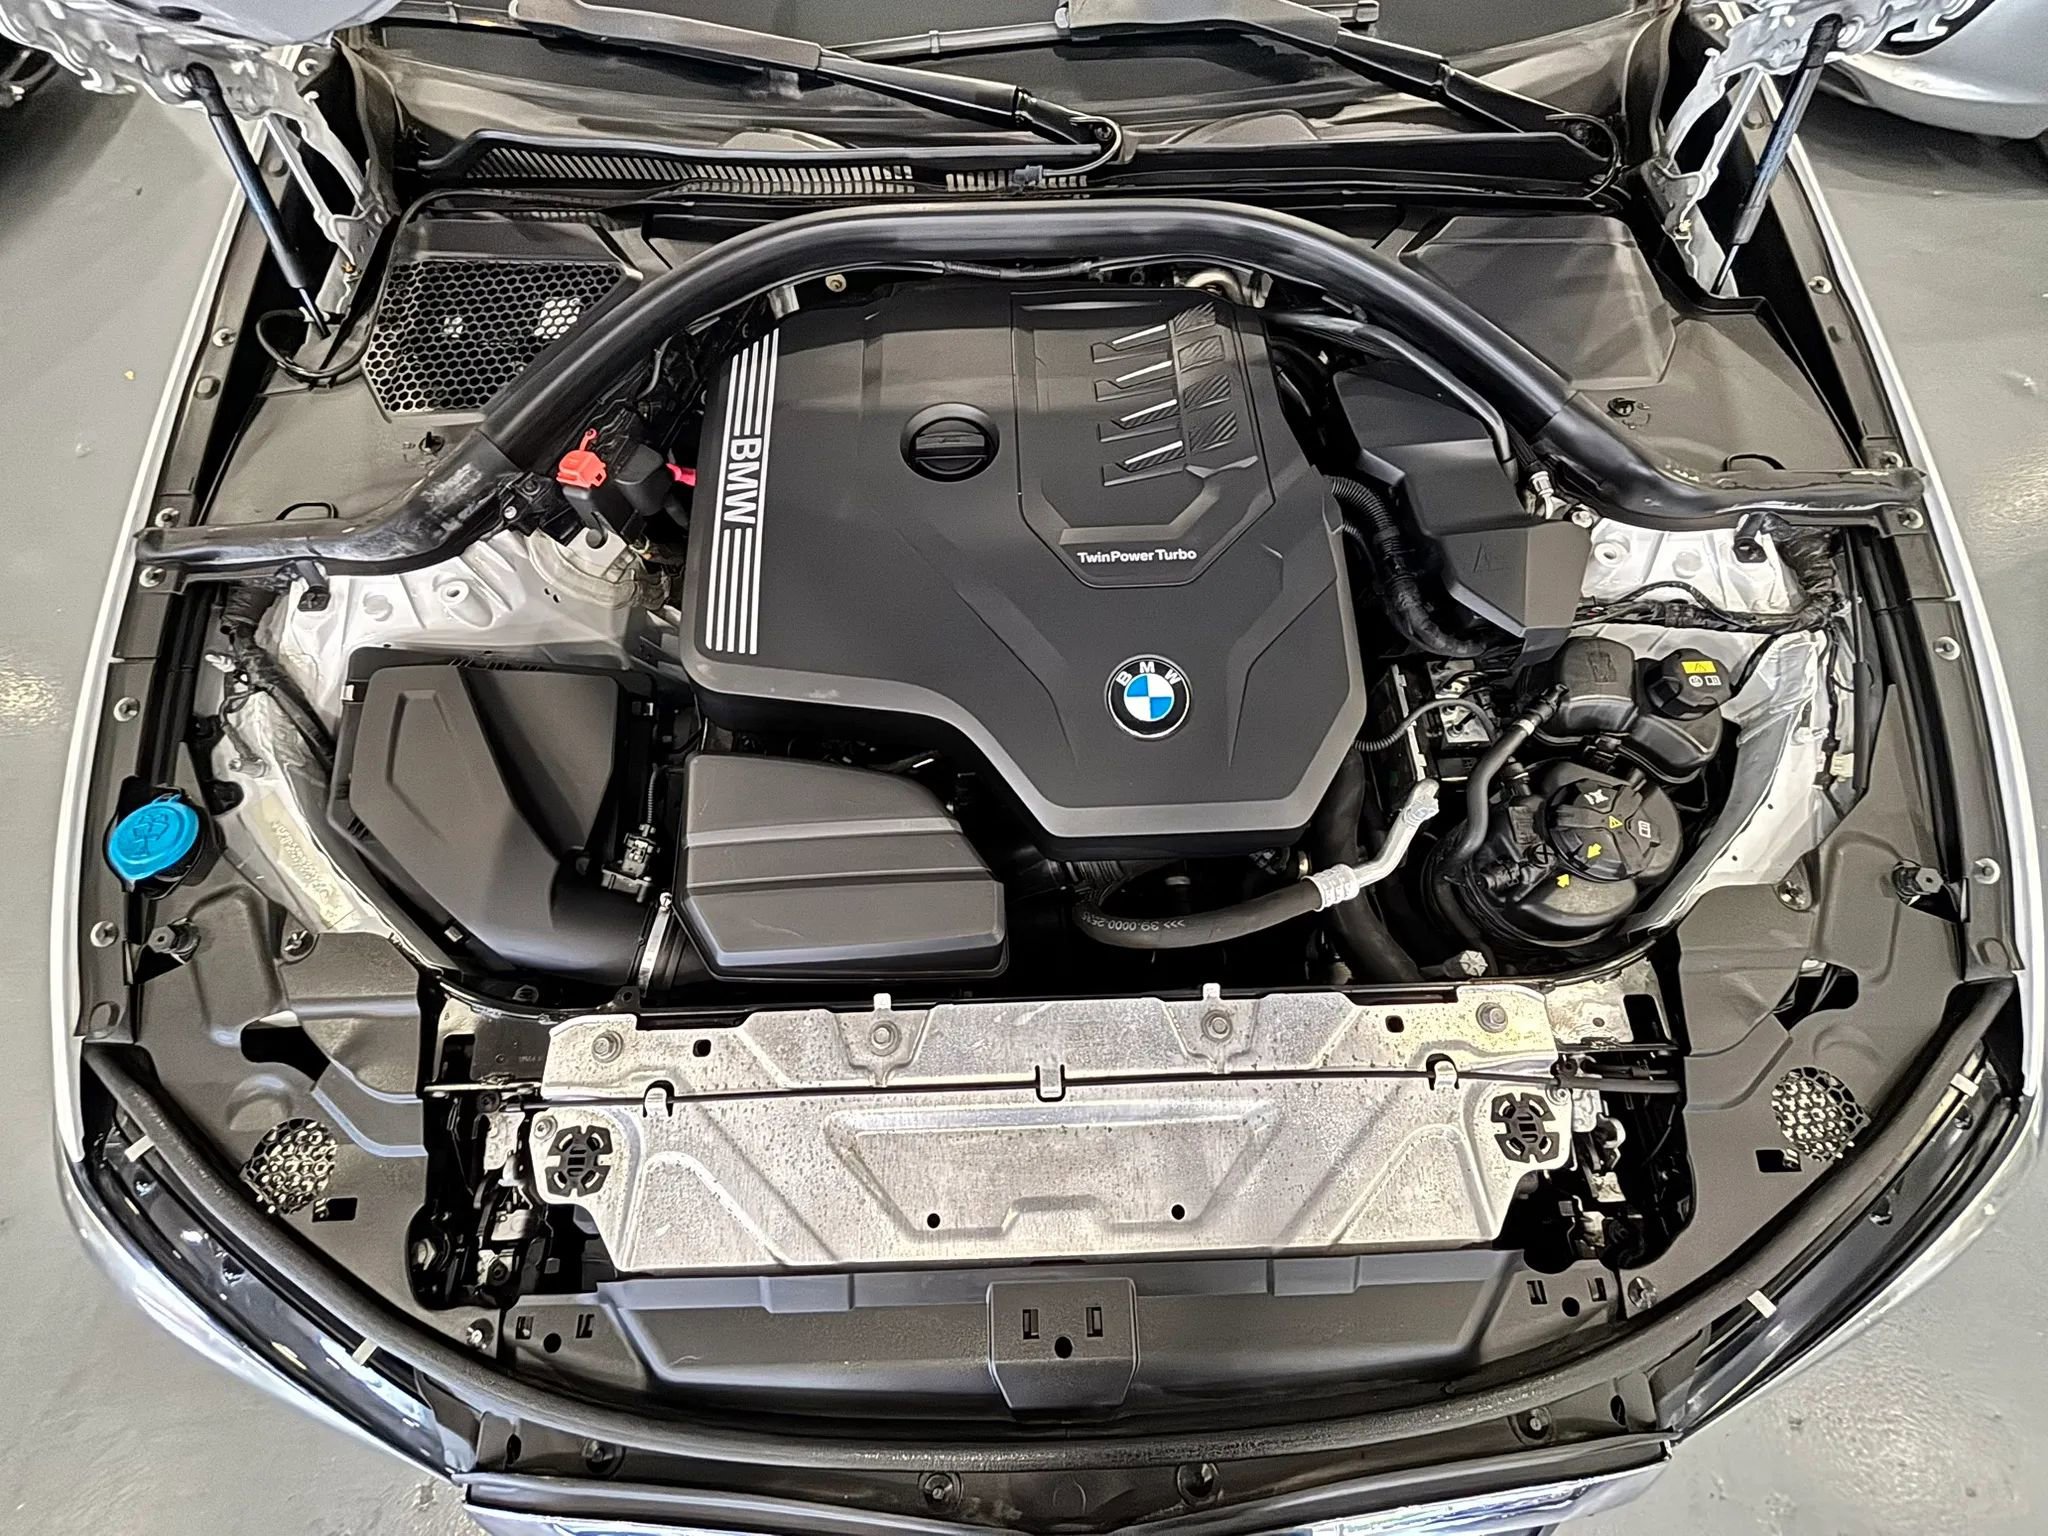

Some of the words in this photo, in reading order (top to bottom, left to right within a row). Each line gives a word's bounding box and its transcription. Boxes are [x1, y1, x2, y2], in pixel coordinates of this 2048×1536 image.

[723, 437, 762, 524] BMW
[1077, 551, 1154, 564] TwinPower
[1155, 548, 1198, 561] Turbo
[1115, 661, 1182, 687] BMW
